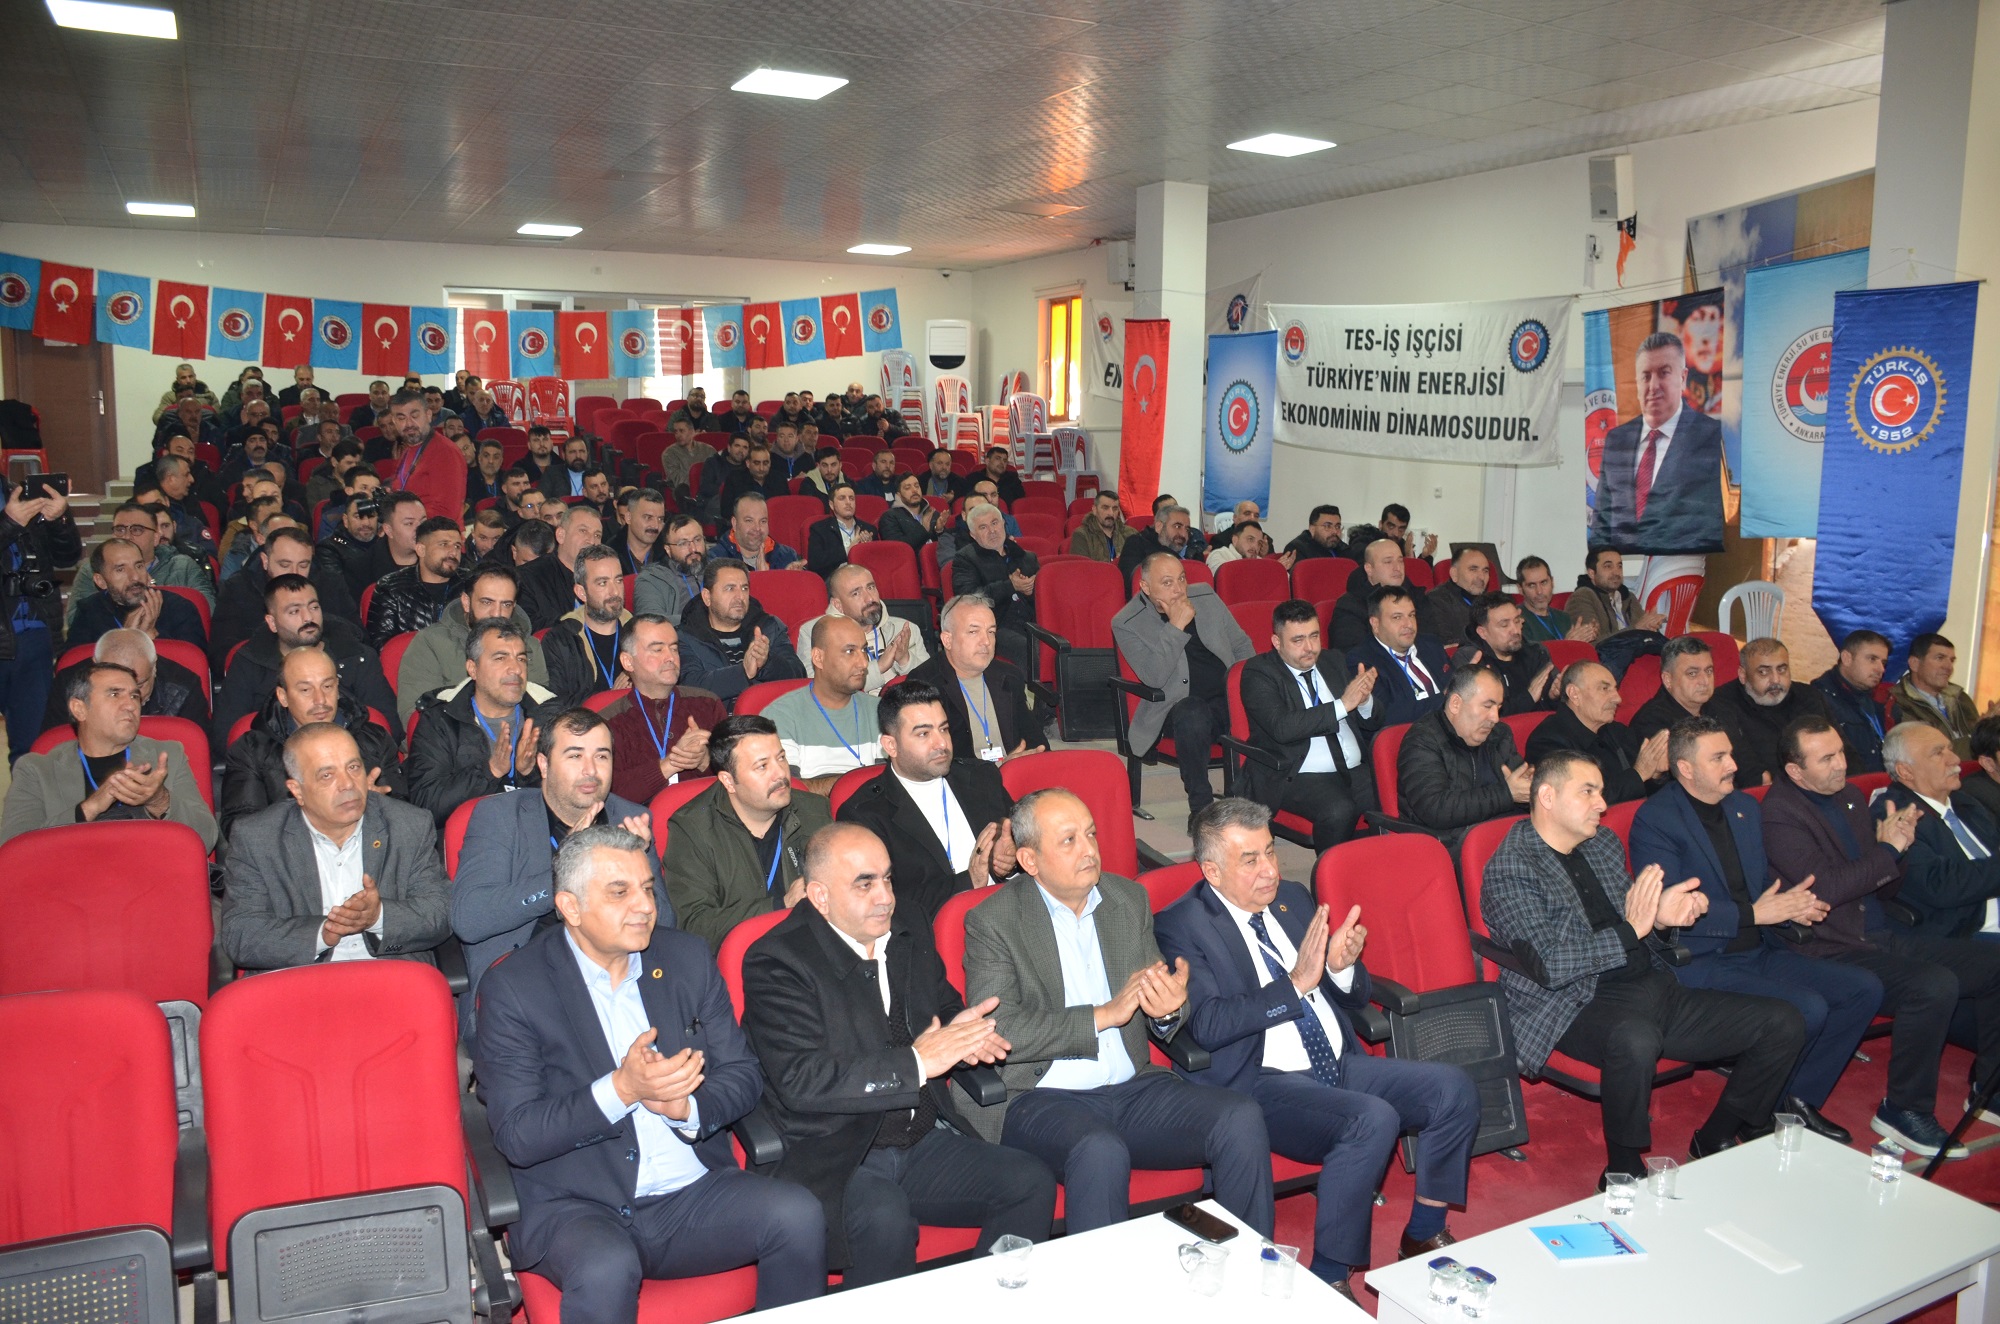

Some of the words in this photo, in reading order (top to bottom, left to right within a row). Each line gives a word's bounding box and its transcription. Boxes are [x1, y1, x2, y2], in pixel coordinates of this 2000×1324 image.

[1345, 324, 1400, 358] TES-İŞ
[1406, 323, 1463, 359] İŞÇİSİ
[1795, 338, 1808, 351] SU
[1809, 331, 1820, 342] VE
[1822, 330, 1833, 339] GA
[1307, 362, 1410, 394] TÜRKİYE'NİN
[1417, 366, 1505, 396] ENERJİSİ
[1864, 361, 1928, 386] TÜRK-İŞ
[1281, 403, 1380, 433] EKONOMİNİN
[1387, 407, 1539, 442] DİNAMOSUDUR.
[1794, 426, 1825, 440] ANKARA
[1870, 425, 1914, 441] 1952
